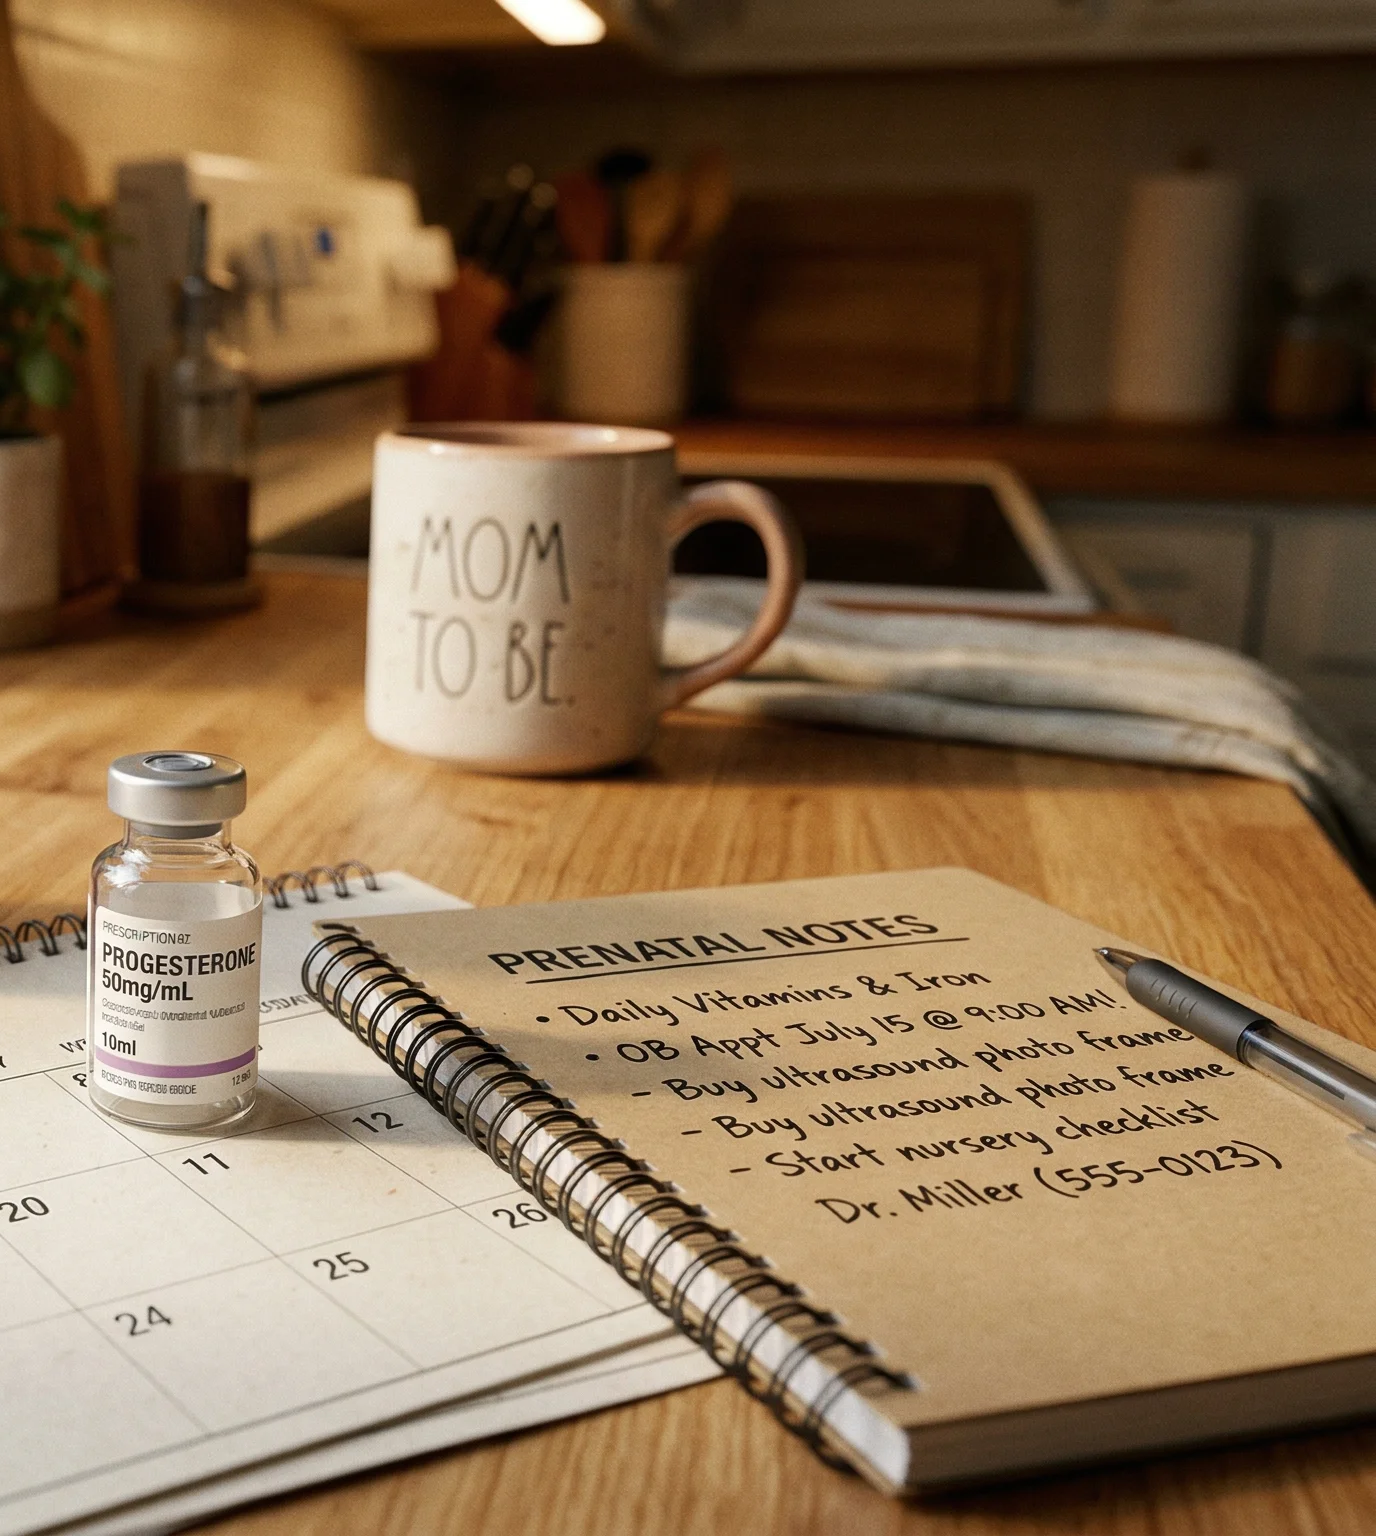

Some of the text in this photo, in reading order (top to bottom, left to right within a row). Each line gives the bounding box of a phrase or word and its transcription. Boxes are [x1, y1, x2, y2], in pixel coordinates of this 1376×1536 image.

[410, 516, 571, 604] MOM
[410, 611, 477, 699] TO
[102, 942, 257, 976] PROGESTERONE
[488, 914, 939, 975] PRENATAL NOTES
[102, 969, 194, 1003] 50mg/mL
[558, 967, 991, 1027] Daily Vitamins & Iron
[102, 1032, 136, 1056] 10ml
[616, 989, 1127, 1063] OB Appt July 15 @ 9:00 AM!
[662, 1028, 1195, 1104] Buy ultrasound photo frame
[712, 1063, 1236, 1141] Buy ultrasound photo frame
[183, 1152, 231, 1176] 11
[352, 1111, 403, 1135] 12
[765, 1099, 1221, 1178] Start nursery checklist
[816, 1139, 1283, 1225] Dr. Miller (555-0123)
[115, 1304, 171, 1338] 24
[313, 1251, 370, 1281] 25
[492, 1202, 548, 1229] 26
